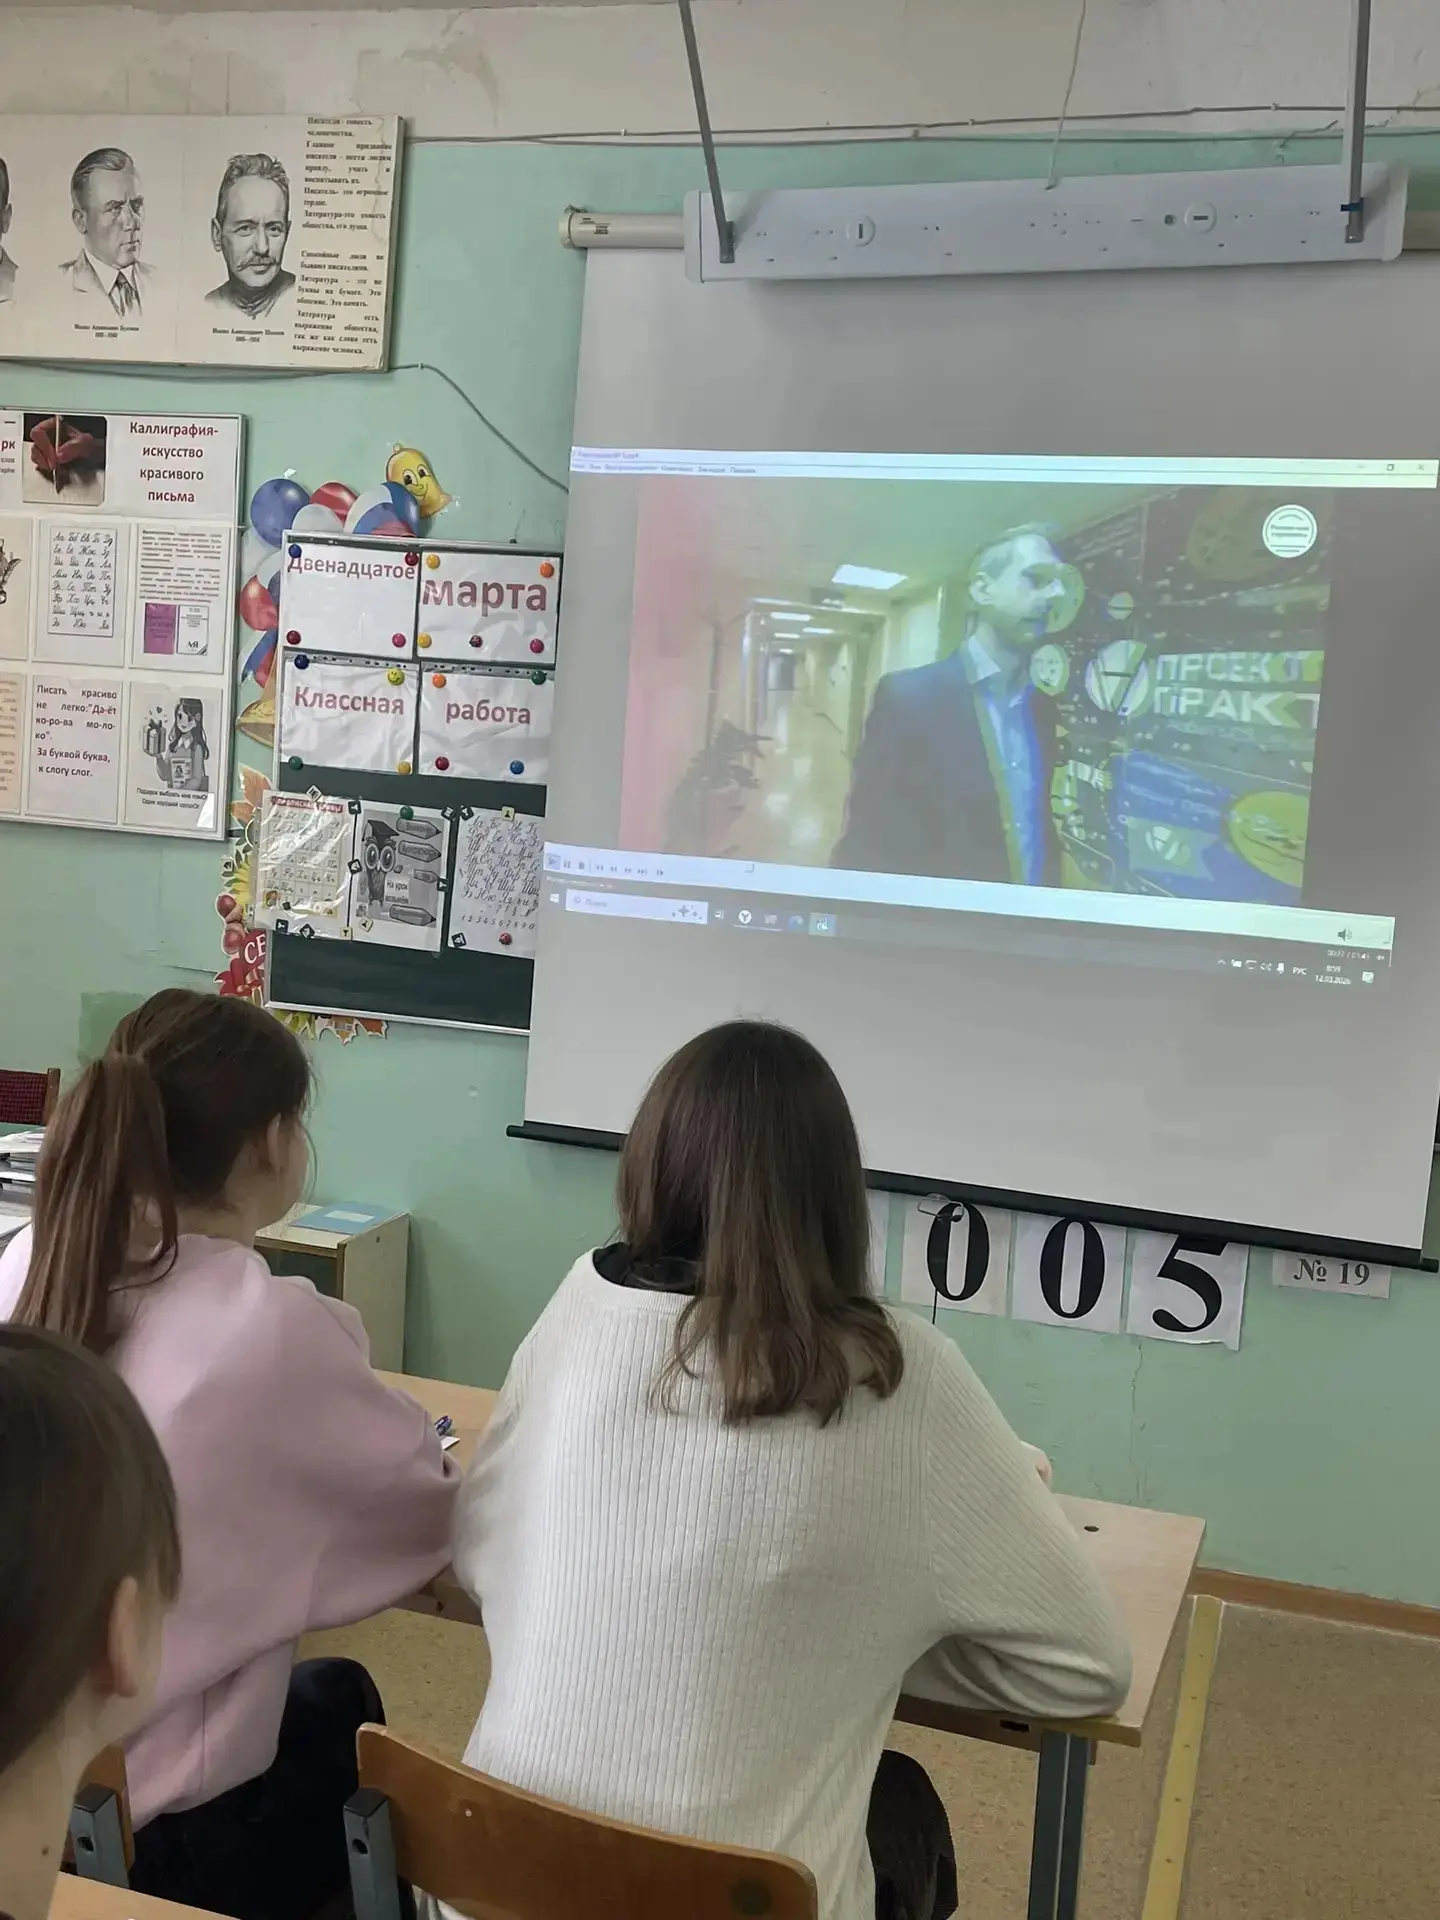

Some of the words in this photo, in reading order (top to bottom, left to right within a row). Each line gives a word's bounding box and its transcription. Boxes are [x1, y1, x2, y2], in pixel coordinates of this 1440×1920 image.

[130, 422, 218, 438] Каллиграфия-
[142, 447, 203, 460] искусство
[140, 469, 204, 481] красивого
[148, 491, 195, 502] письма
[287, 556, 415, 579] Двенадцатое
[421, 579, 547, 617] марта
[37, 685, 67, 695] Писать
[81, 689, 117, 699] красиво
[36, 701, 47, 709] не
[295, 686, 404, 715] Классная
[446, 699, 531, 724] работа
[35, 717, 73, 726] ко-ро-ва
[86, 721, 115, 730] мо-ло-
[37, 747, 47, 756] За
[49, 748, 80, 758] буквой
[82, 751, 111, 763] буква,
[46, 766, 69, 776] слогу
[71, 768, 93, 777] слог.
[1293, 1259, 1327, 1282] №
[1338, 1262, 1370, 1286] 19
